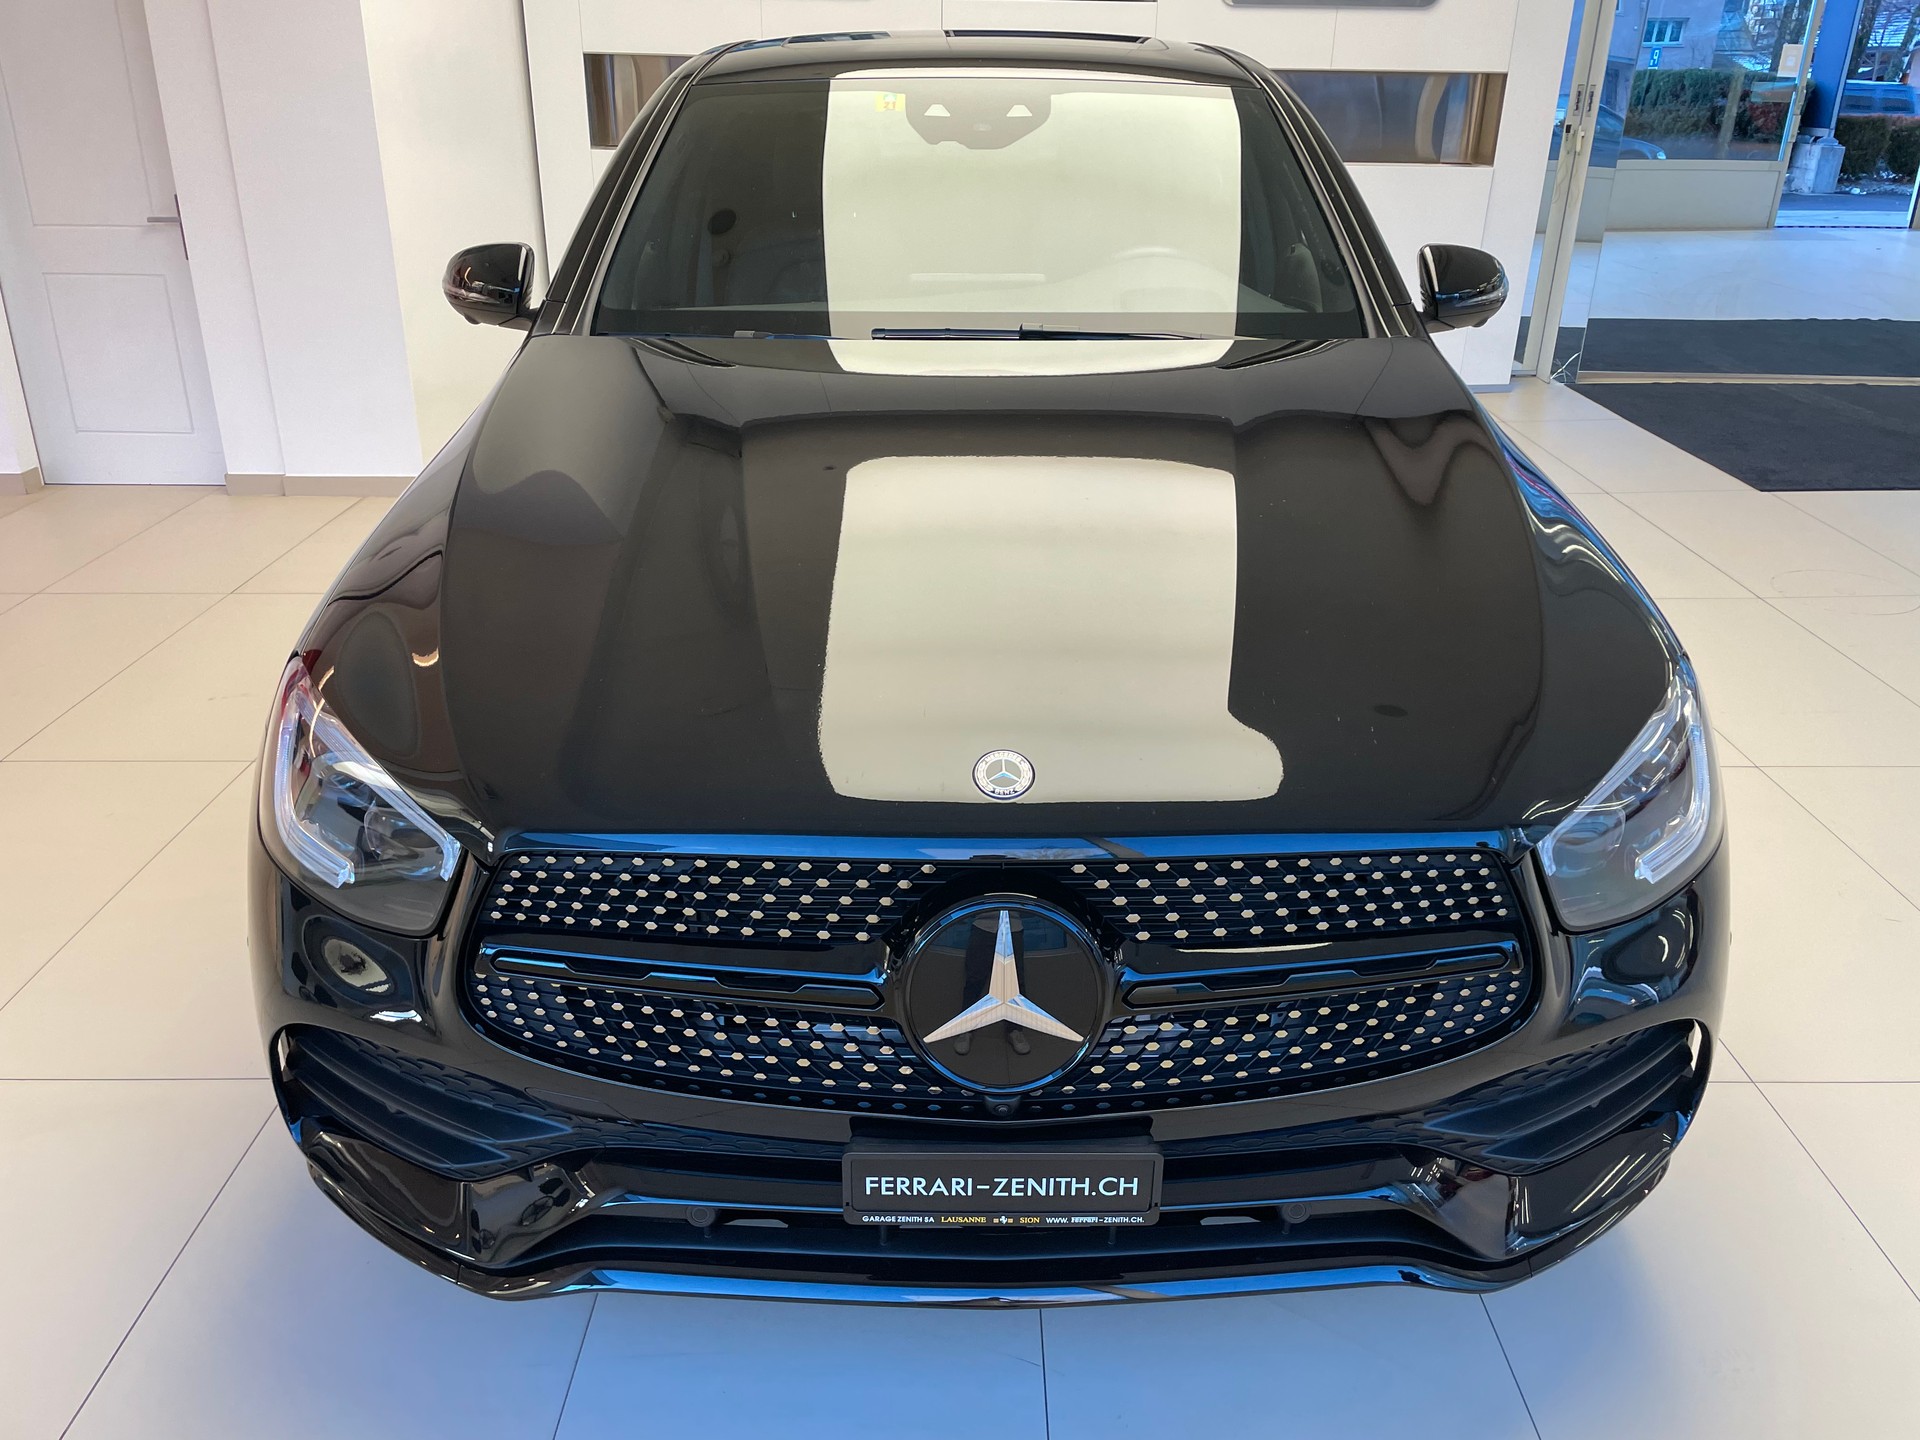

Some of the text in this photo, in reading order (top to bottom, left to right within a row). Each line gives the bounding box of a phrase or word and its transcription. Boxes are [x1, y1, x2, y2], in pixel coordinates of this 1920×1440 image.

[865, 1177, 1139, 1197] FERRARI-ZENITH.CH
[862, 1215, 896, 1223] GARAGE
[897, 1215, 922, 1223] ZENITH
